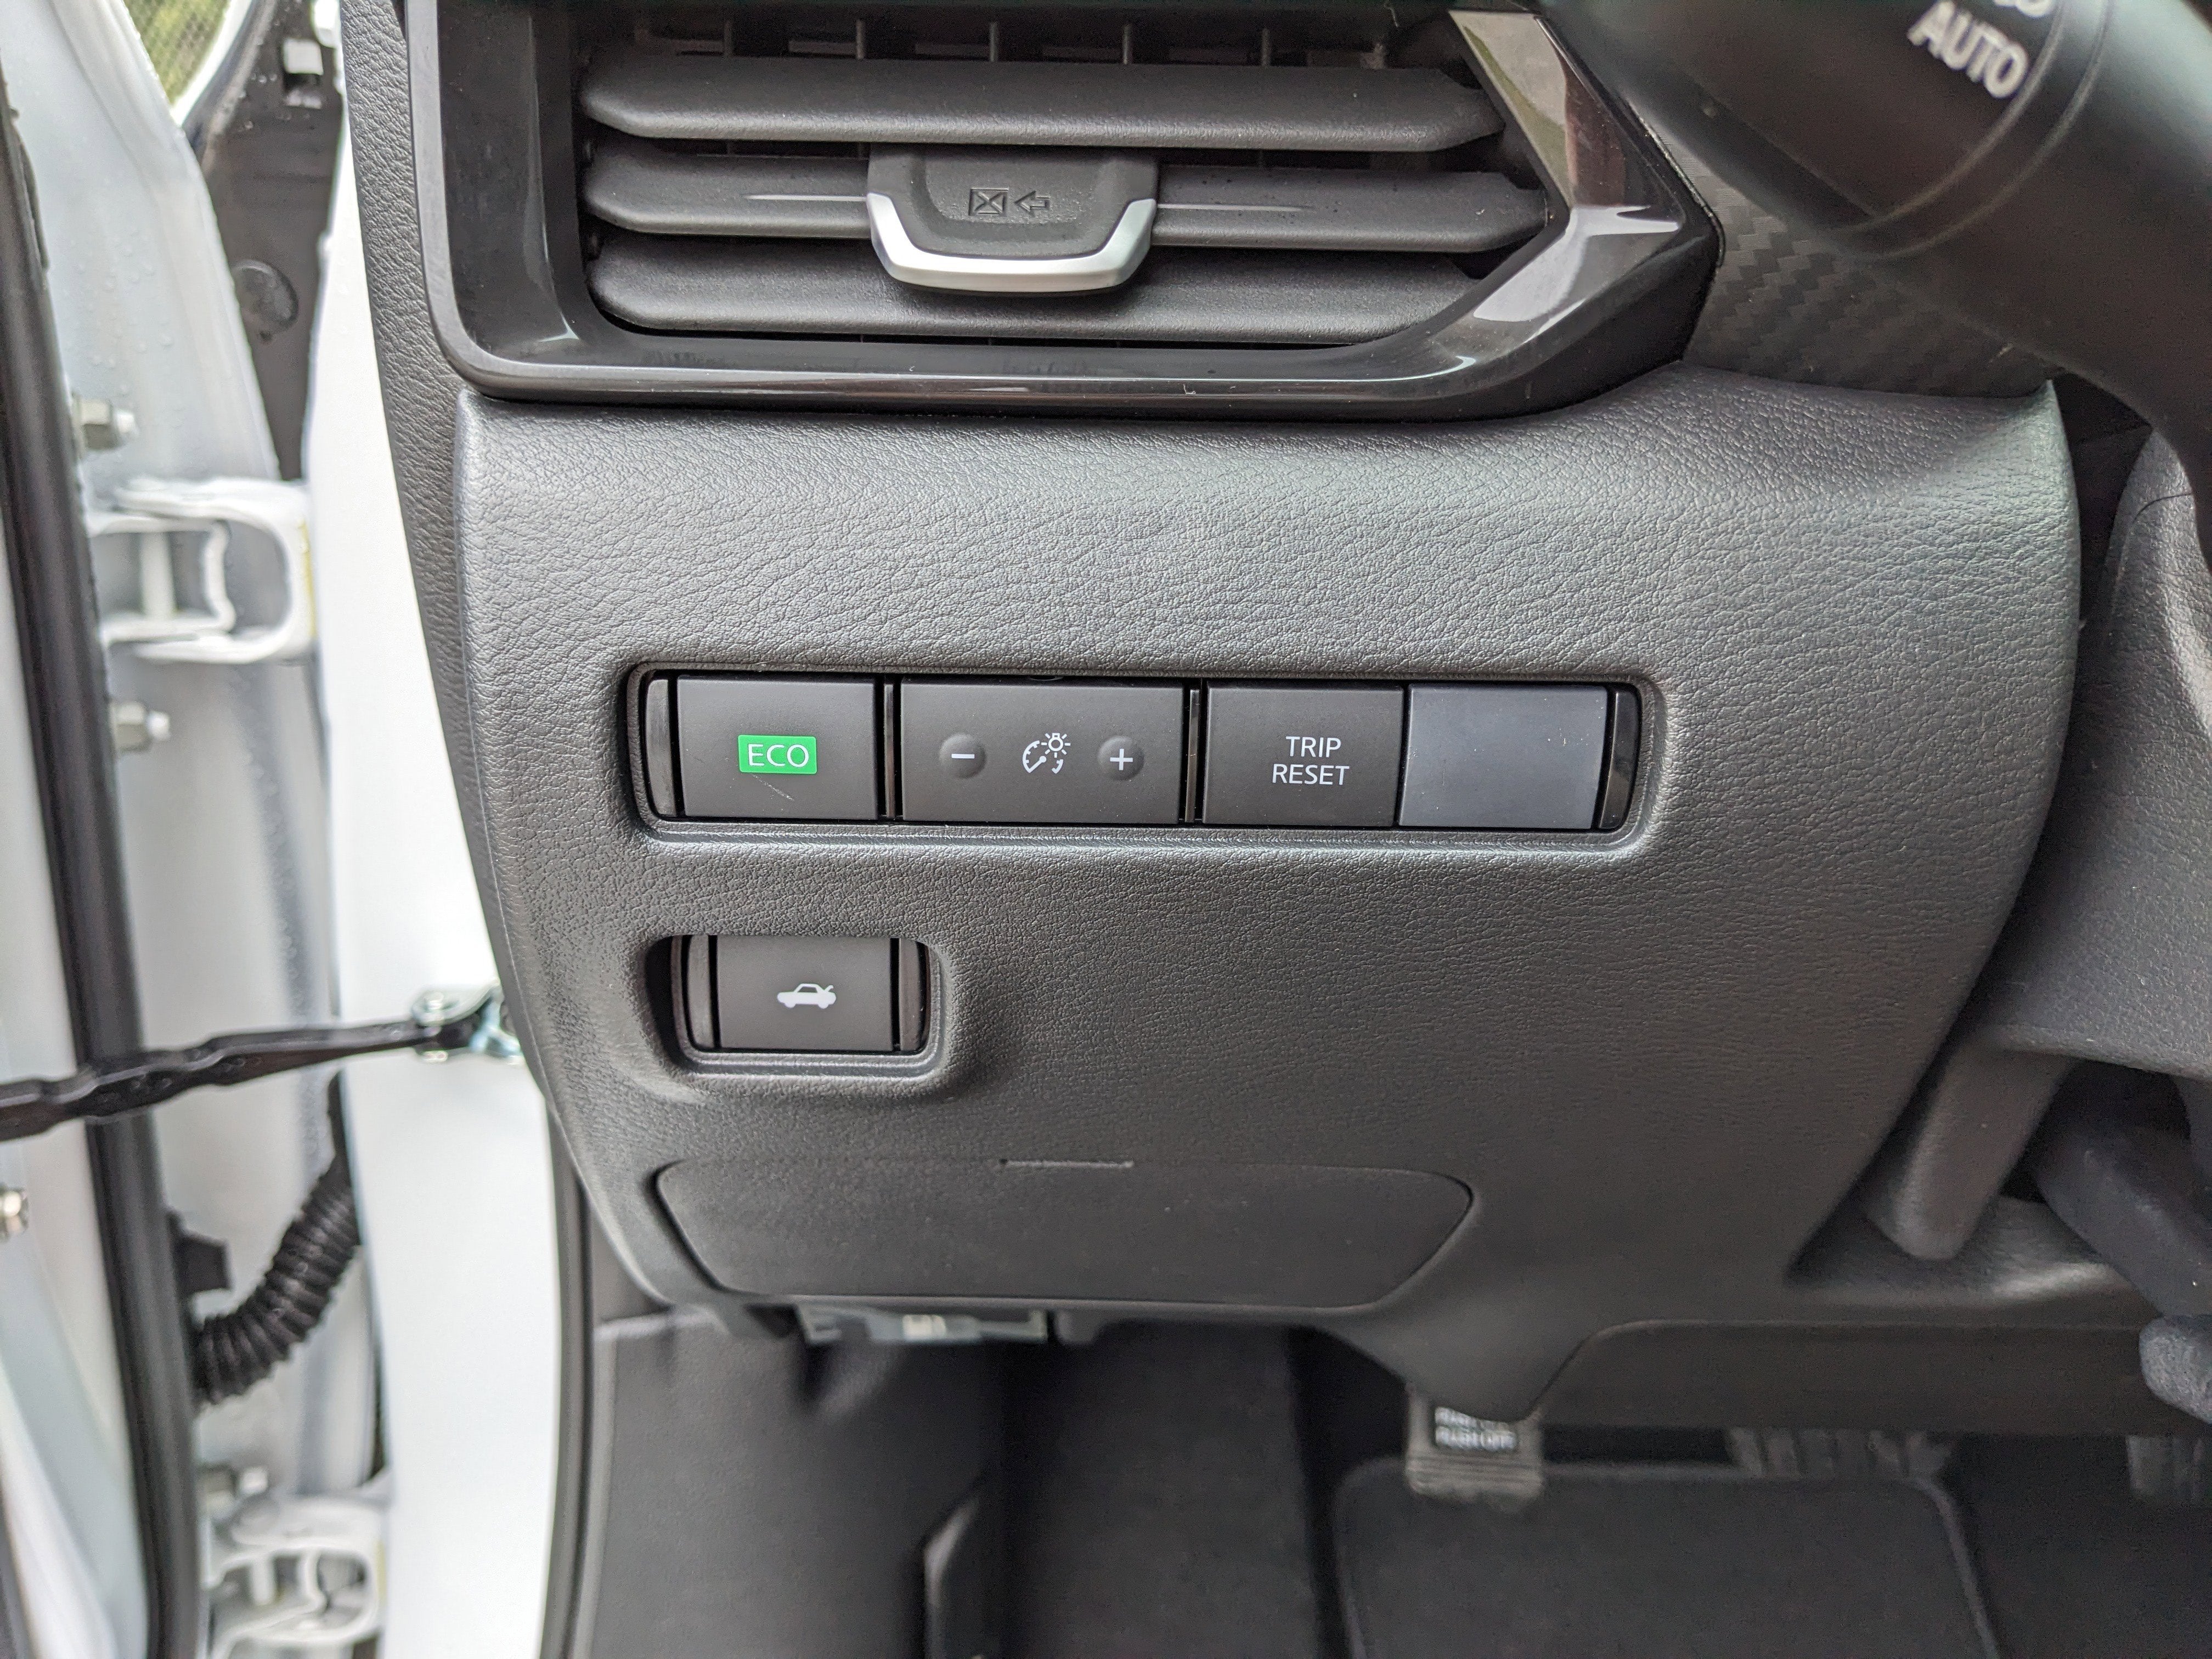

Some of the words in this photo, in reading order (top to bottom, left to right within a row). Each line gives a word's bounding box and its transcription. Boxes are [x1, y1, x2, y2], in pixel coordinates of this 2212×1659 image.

[1906, 0, 2028, 98] AUTO
[748, 743, 809, 768] ECO
[1285, 736, 1341, 758] TRIP
[1272, 763, 1350, 786] RESET
